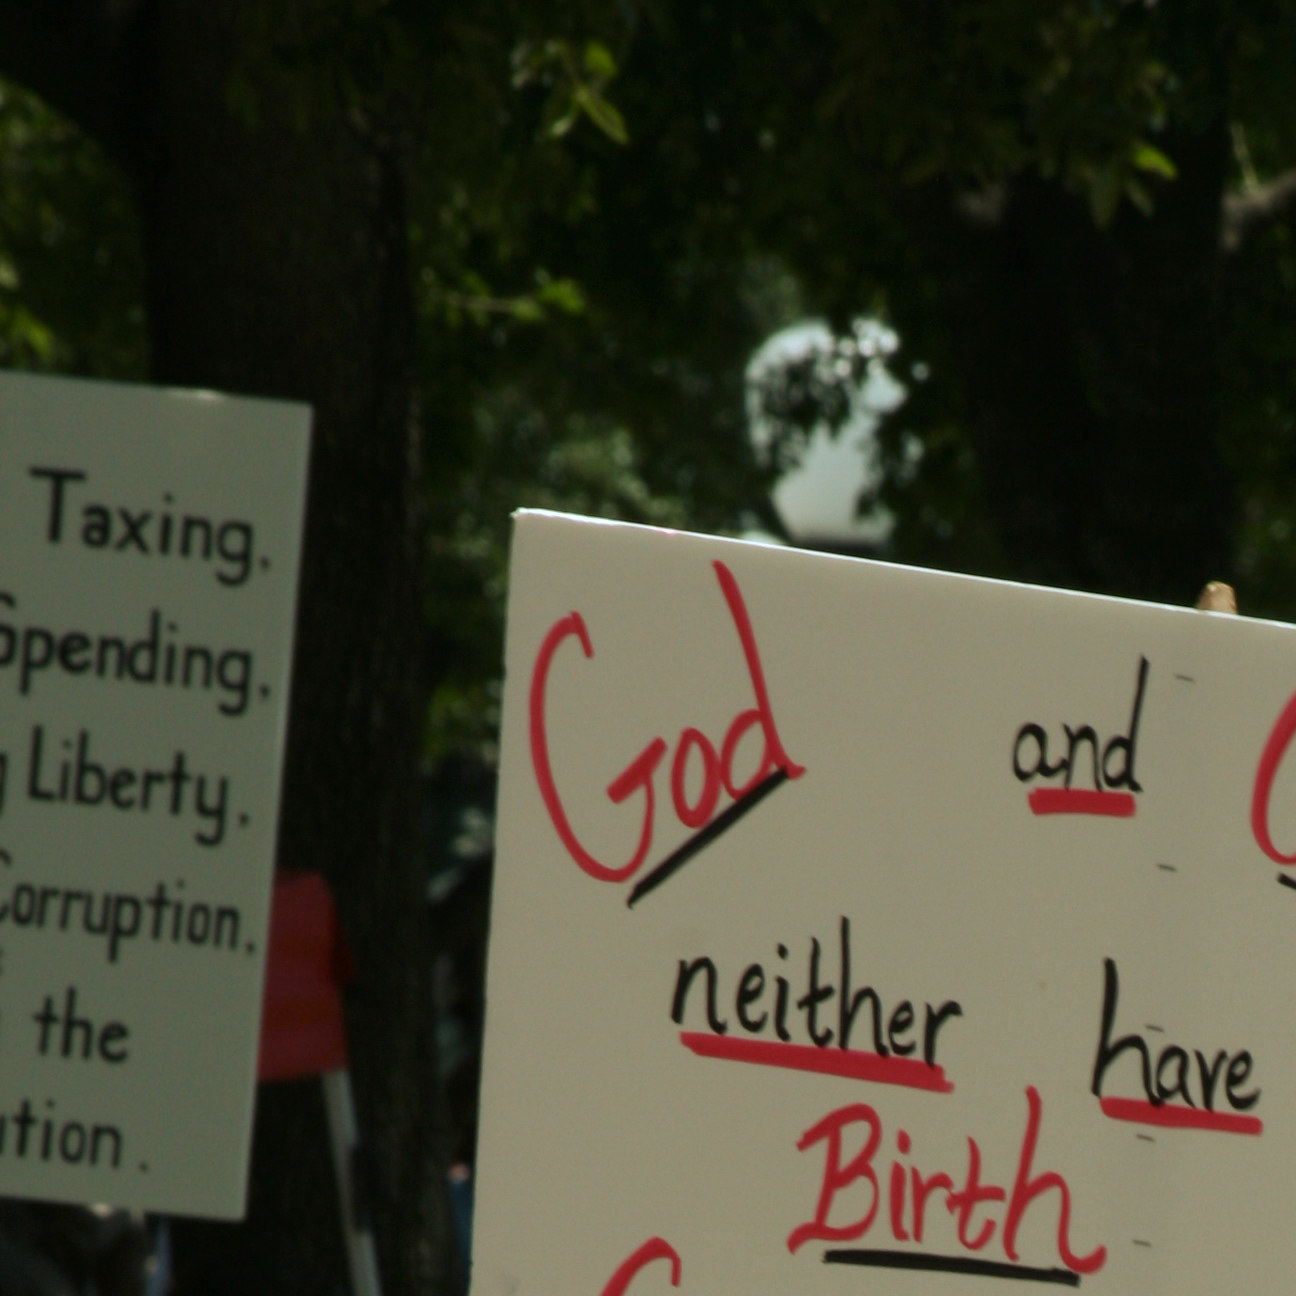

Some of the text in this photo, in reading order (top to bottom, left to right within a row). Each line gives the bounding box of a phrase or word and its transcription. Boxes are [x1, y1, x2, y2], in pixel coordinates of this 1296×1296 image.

[28, 465, 271, 588] Taxing.
[27, 725, 250, 848] Liberty.
[528, 558, 806, 884] God
[1011, 655, 1150, 793] and
[33, 986, 131, 1064] the
[670, 914, 963, 1069] neither
[1090, 956, 1261, 1112] have
[786, 1086, 1109, 1275] Birth
